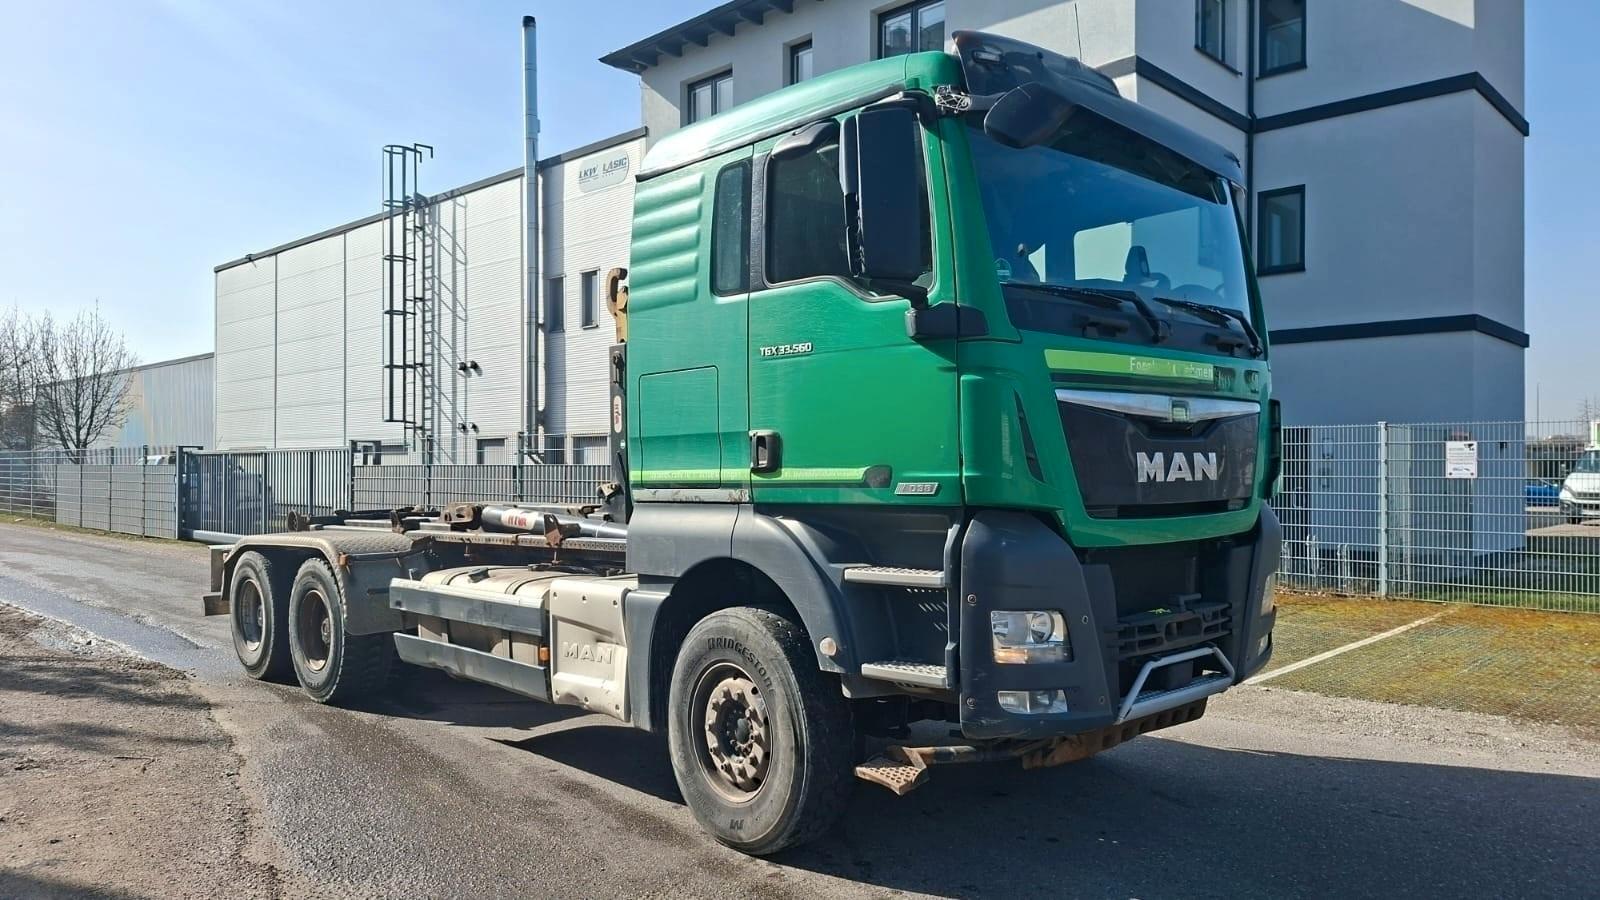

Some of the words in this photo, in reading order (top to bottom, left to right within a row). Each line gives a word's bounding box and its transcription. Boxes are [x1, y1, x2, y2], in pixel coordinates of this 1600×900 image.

[579, 164, 599, 178] LKW
[1136, 451, 1218, 483] MAN
[562, 641, 613, 665] MAN
